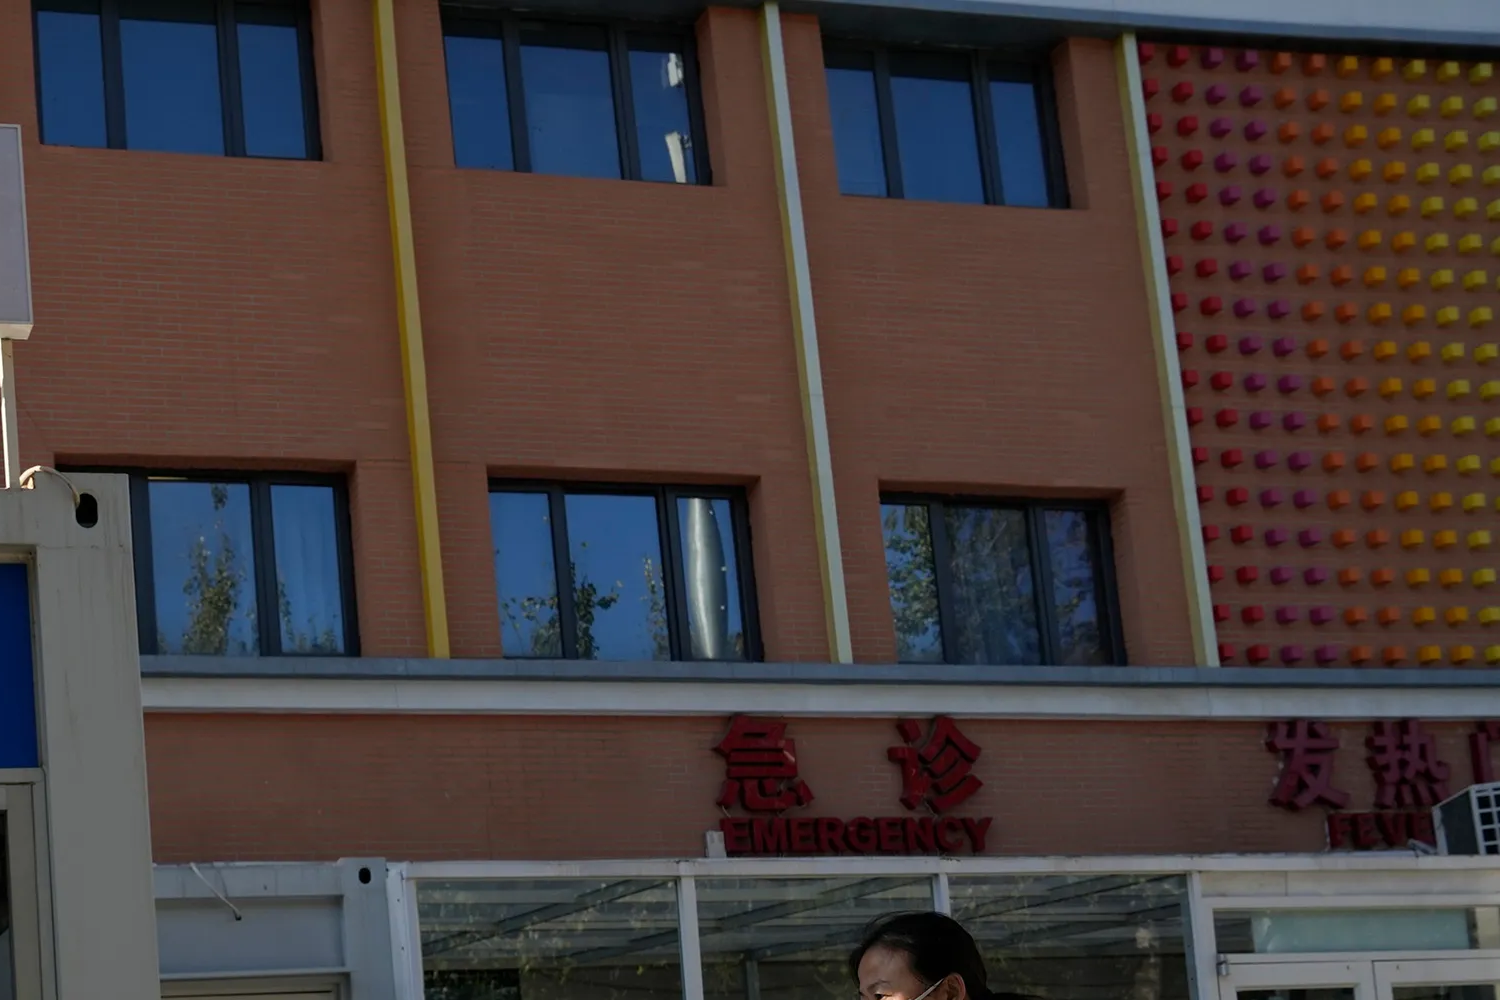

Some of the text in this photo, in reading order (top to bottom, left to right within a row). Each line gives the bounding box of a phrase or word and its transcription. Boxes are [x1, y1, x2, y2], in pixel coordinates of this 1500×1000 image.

[713, 715, 983, 812] 急诊
[1266, 719, 1500, 811] 发热
[720, 817, 993, 854] EMERGENCY
